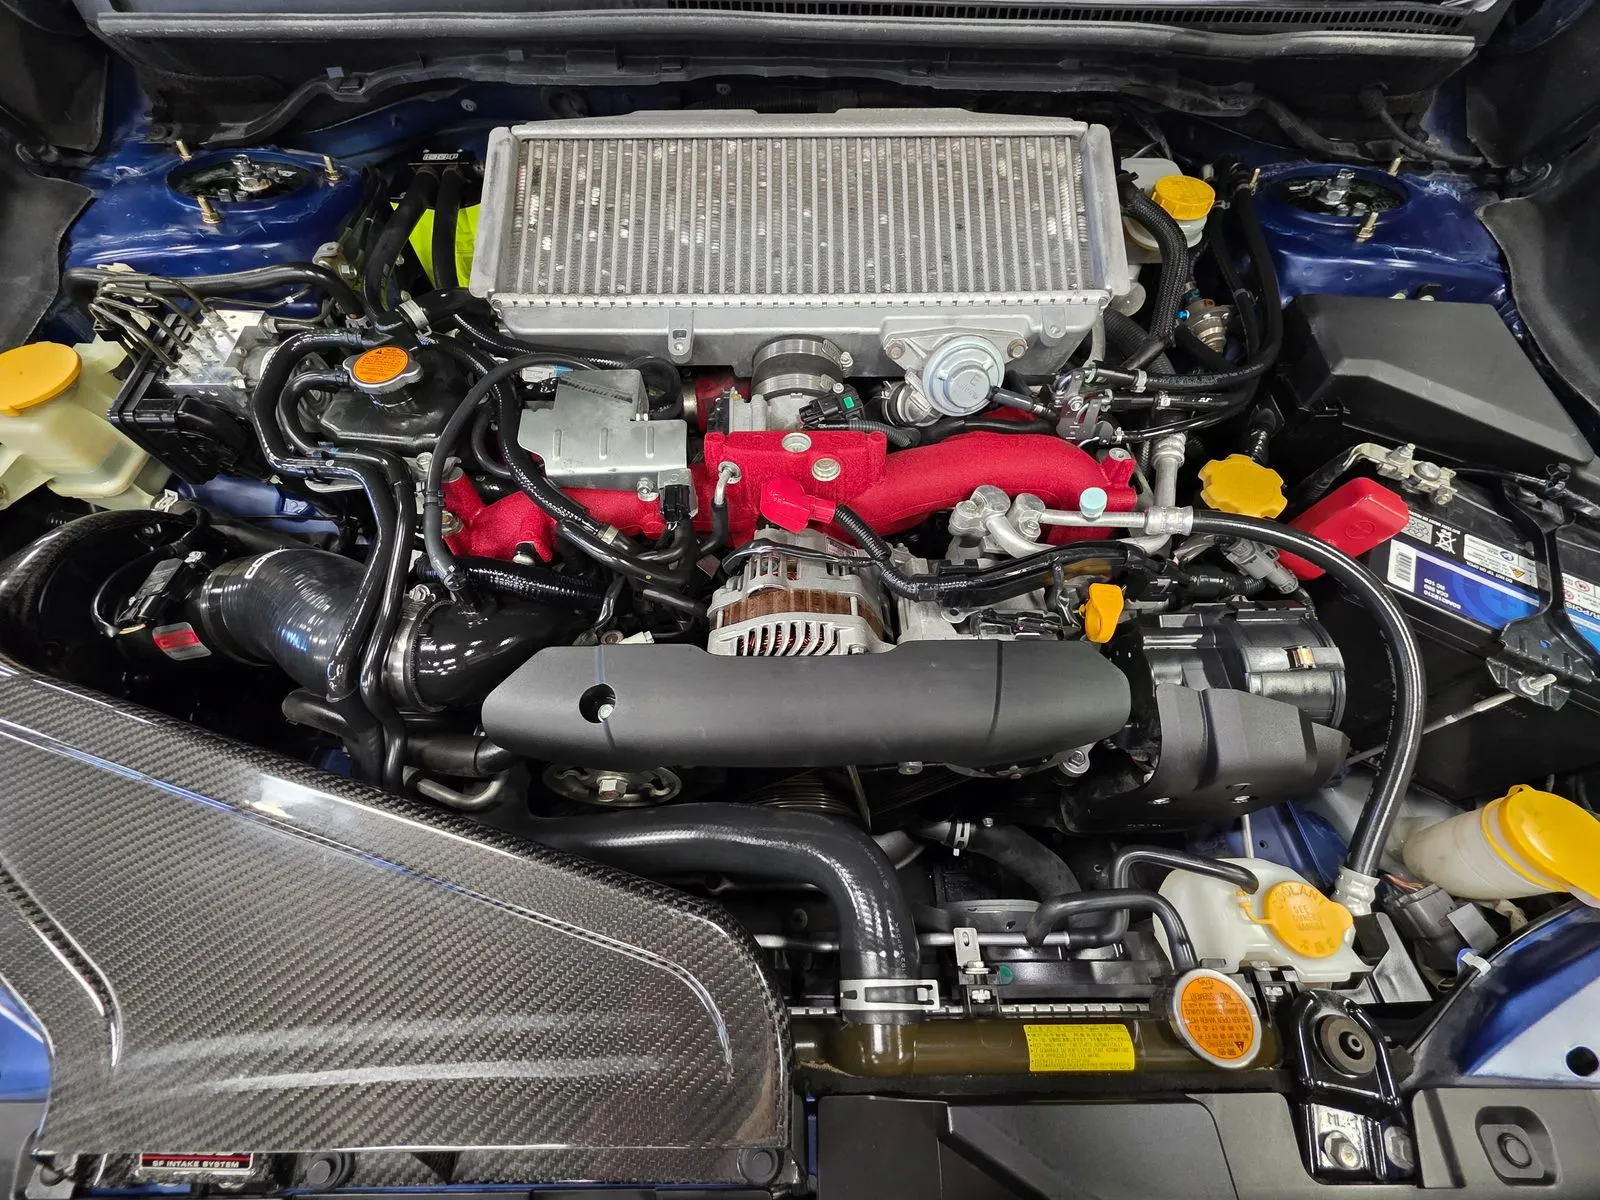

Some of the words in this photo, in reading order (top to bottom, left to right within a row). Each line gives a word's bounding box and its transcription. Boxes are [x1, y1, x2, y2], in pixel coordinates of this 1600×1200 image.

[1436, 587, 1449, 598] CCA
[166, 1160, 200, 1168] INTAKE
[202, 1160, 240, 1168] SYSTEM
